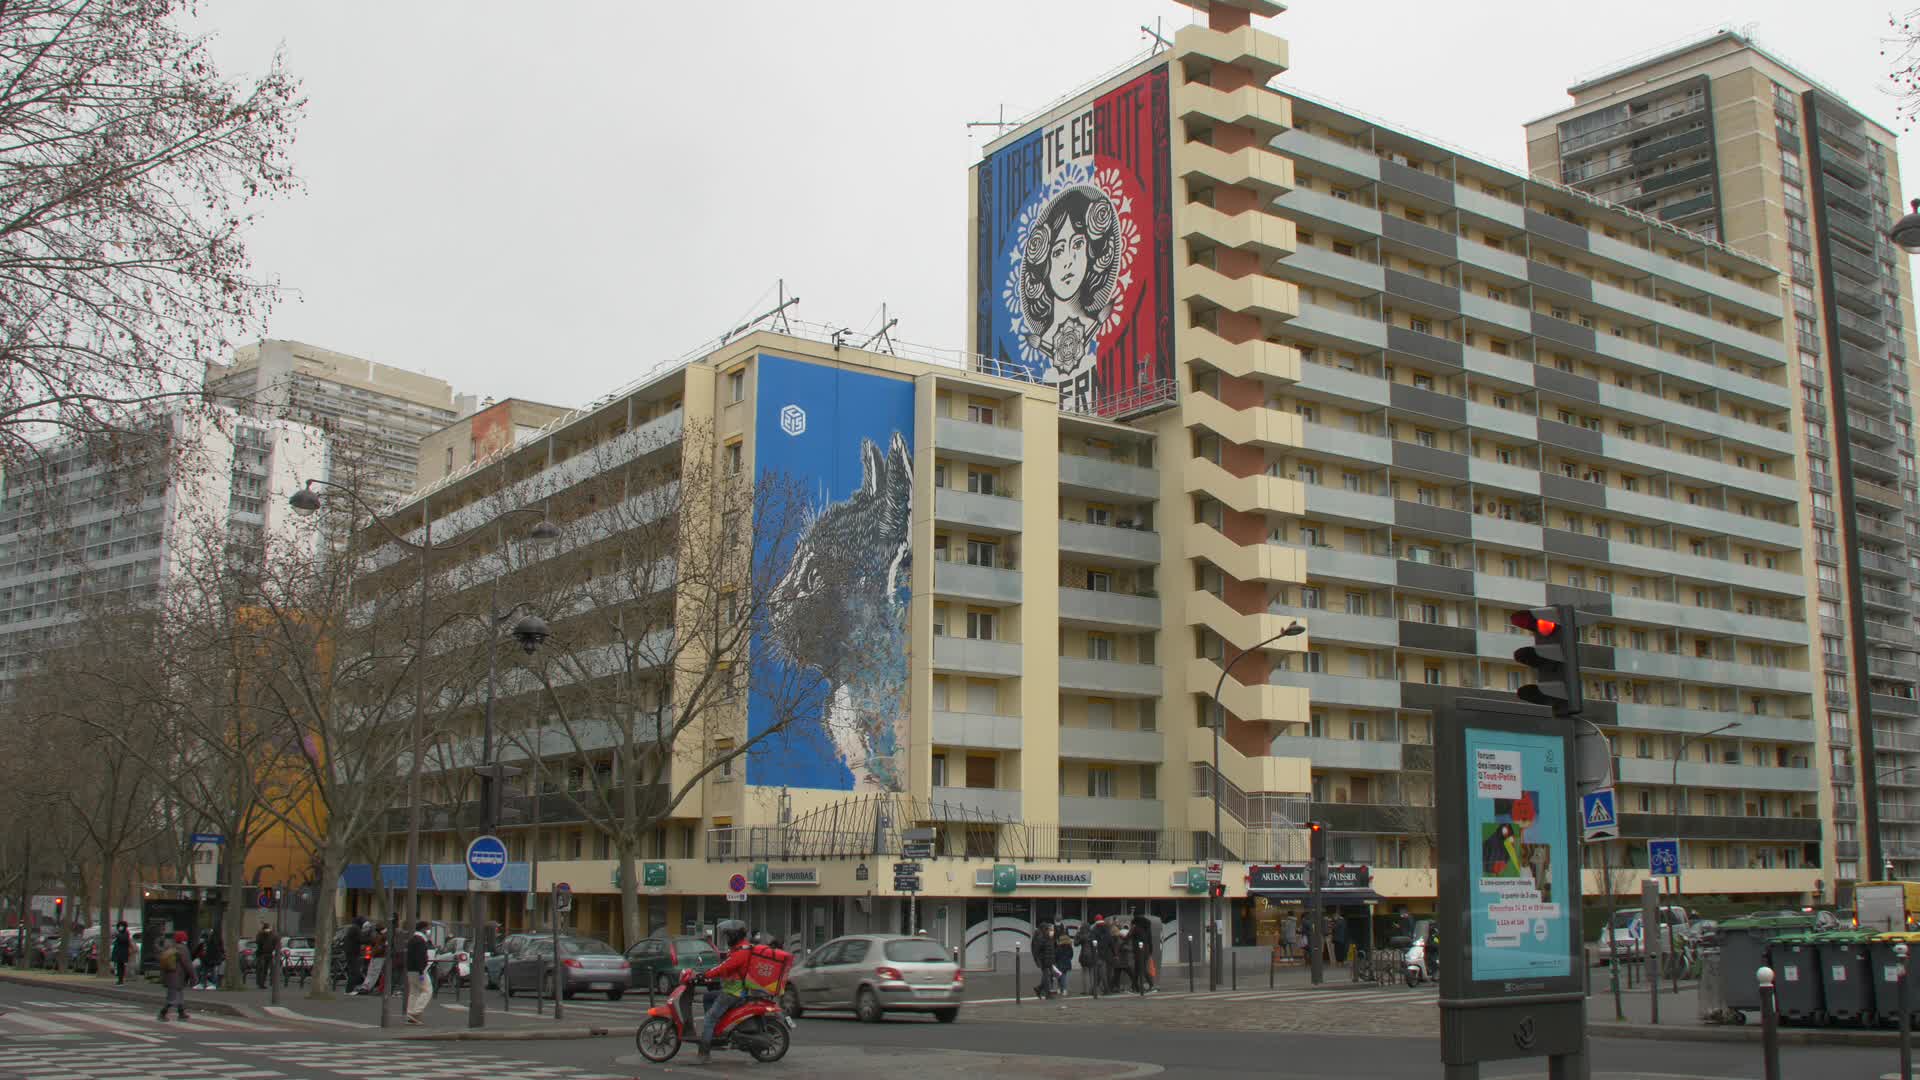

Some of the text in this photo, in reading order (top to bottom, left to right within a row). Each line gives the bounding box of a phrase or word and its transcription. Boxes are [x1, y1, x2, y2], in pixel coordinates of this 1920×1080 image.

[994, 82, 1147, 258] LIBERTE EGALITE
[1044, 874, 1086, 882] PARIBAS
[1261, 872, 1289, 881] ARTISAN
